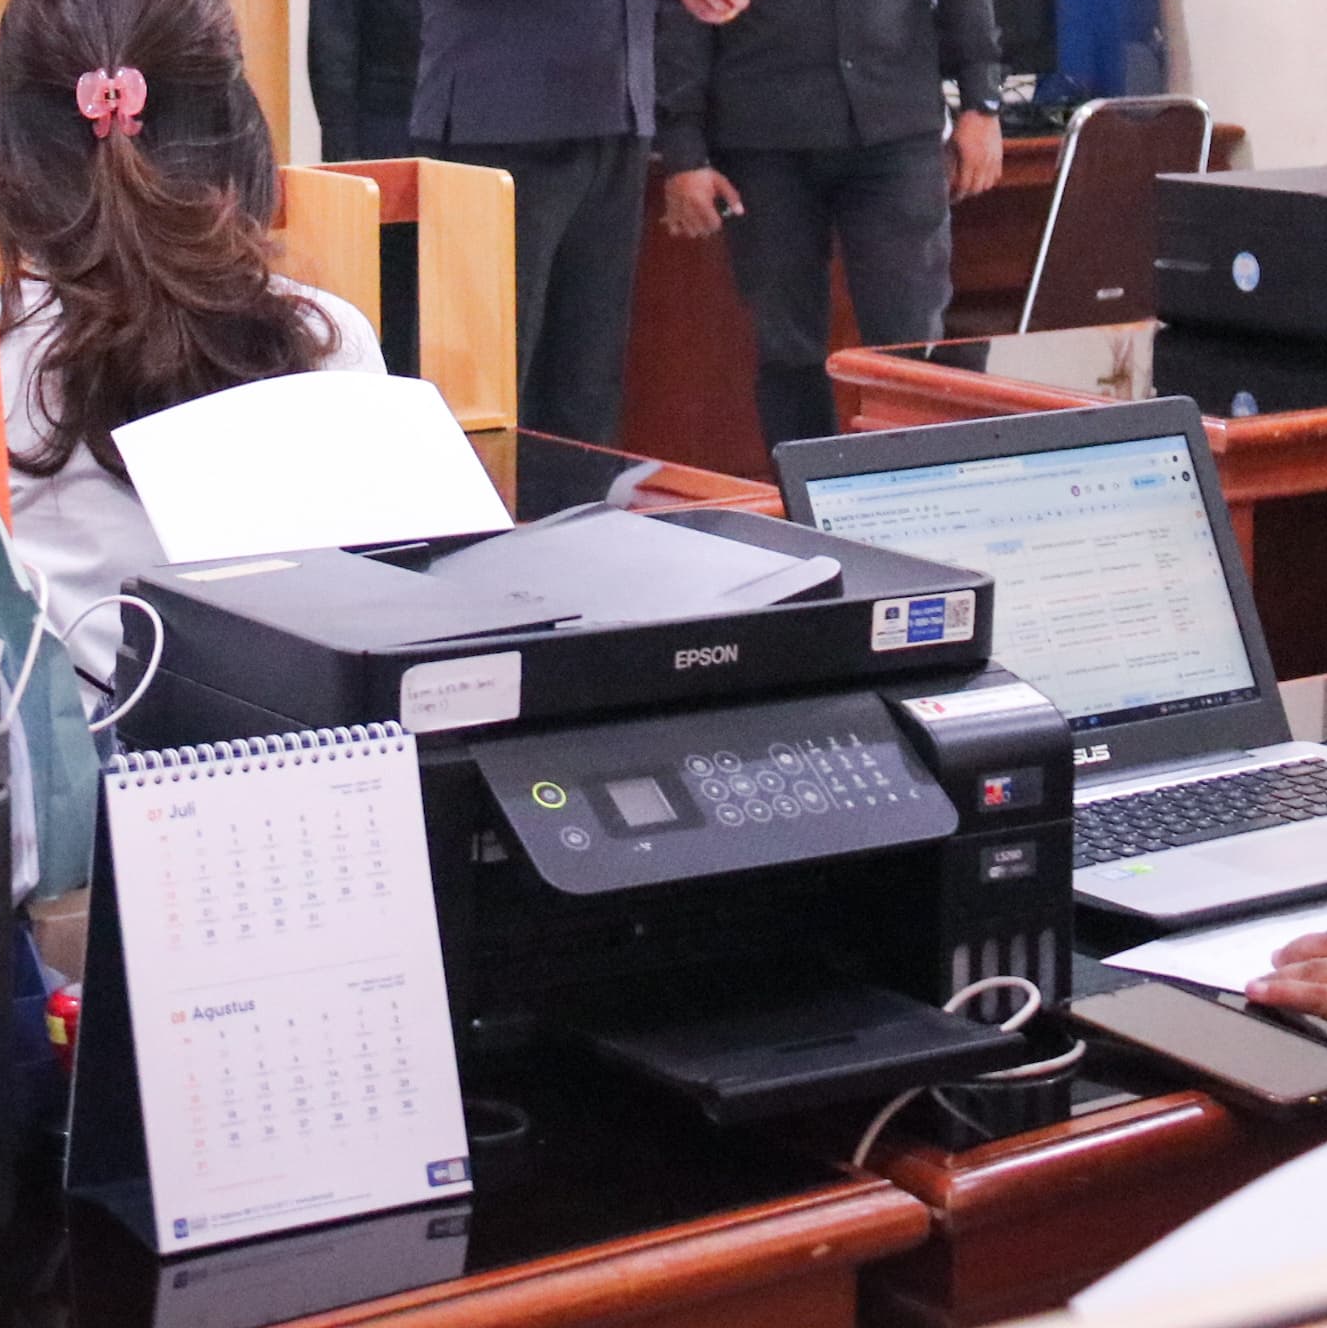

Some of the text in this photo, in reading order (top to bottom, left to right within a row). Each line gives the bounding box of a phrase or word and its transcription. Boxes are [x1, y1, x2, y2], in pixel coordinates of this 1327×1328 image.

[674, 643, 739, 670] EPSON
[1073, 743, 1111, 767] SUS
[169, 802, 196, 819] Juli
[192, 999, 256, 1022] Agustus
